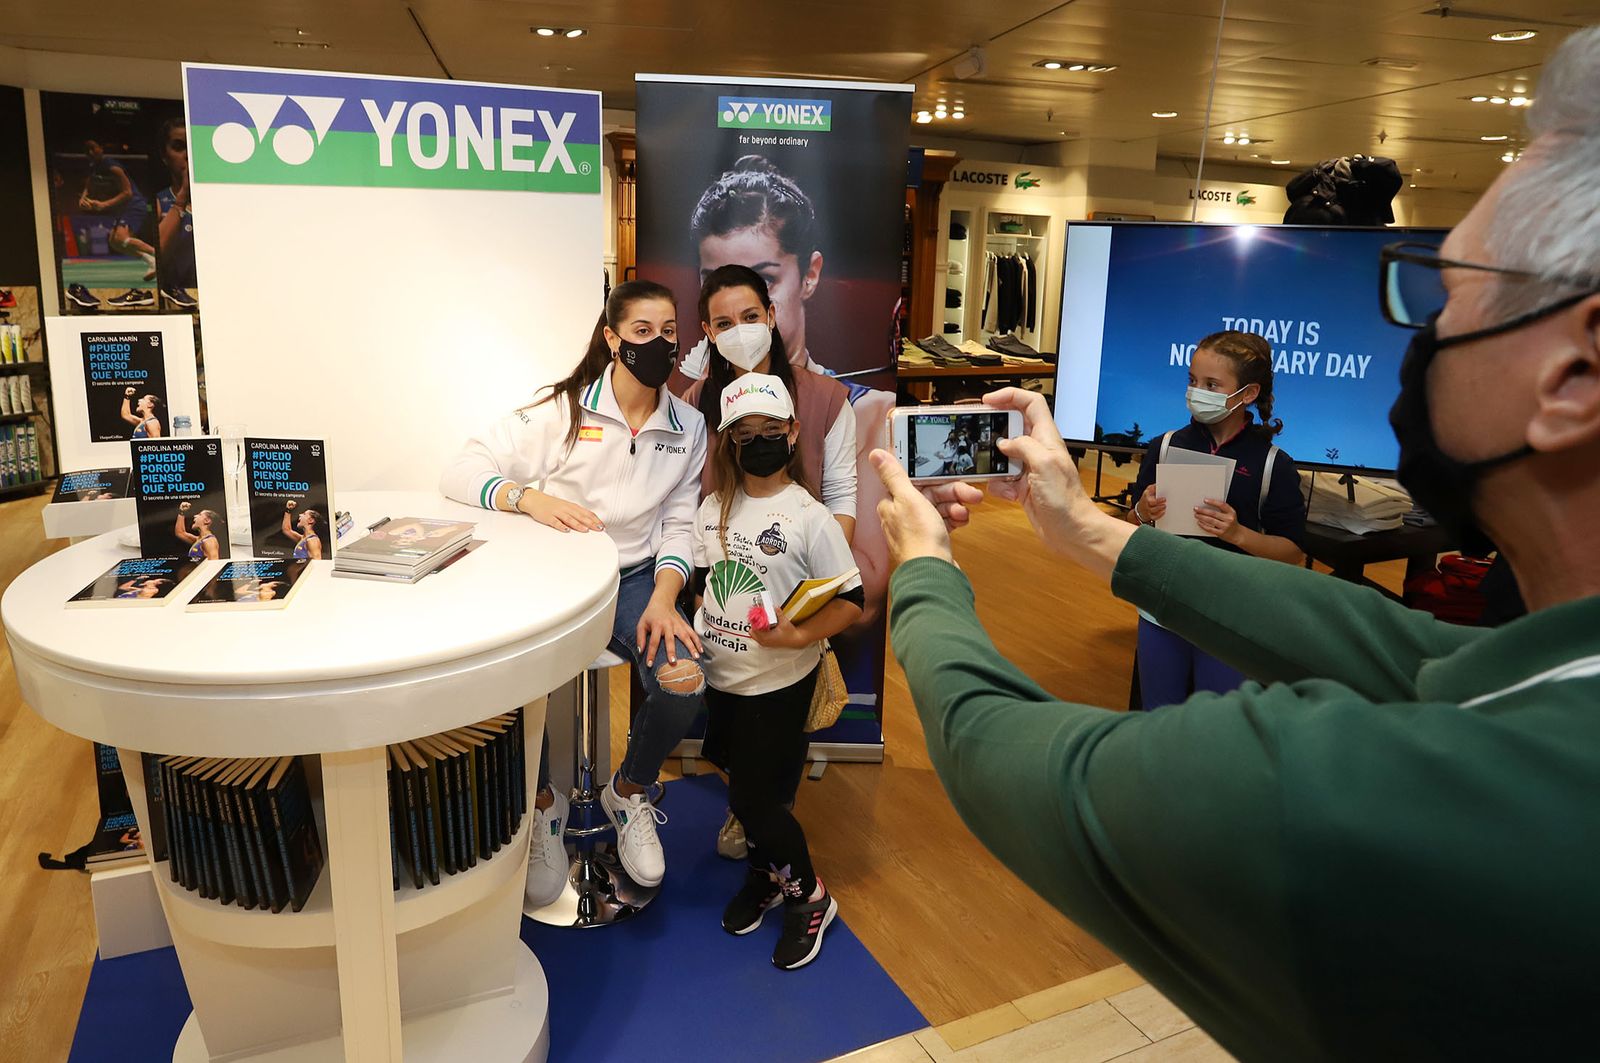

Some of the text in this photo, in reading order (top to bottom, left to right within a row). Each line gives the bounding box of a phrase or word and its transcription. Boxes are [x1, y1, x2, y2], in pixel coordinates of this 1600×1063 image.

[762, 103, 825, 126] YONEX
[739, 135, 809, 147] far beyond ordinary
[952, 169, 1008, 185] LACOSTE
[1222, 317, 1321, 346] TODAY IS
[89, 343, 131, 352] #PUEDO
[89, 353, 131, 361] PORQUE
[90, 362, 128, 371] PIENSO
[1325, 353, 1372, 379] DAY
[91, 370, 148, 380] QUE PUEDO
[172, 443, 194, 451] MARÍN
[250, 442, 299, 451] CAROLINA MARÍN
[665, 444, 687, 454] YONEX
[140, 453, 186, 463] #PUEDO
[252, 451, 292, 461] #PUEDO
[140, 463, 186, 473] PORQUE
[252, 461, 292, 471] PORQUE
[141, 473, 182, 484] PIENSO
[253, 471, 289, 480] PIENSO
[142, 482, 205, 494] QUE PUEDO
[254, 480, 309, 491] QUE PUEDO
[703, 607, 752, 633] Fundació
[703, 629, 748, 653] Unicaja
